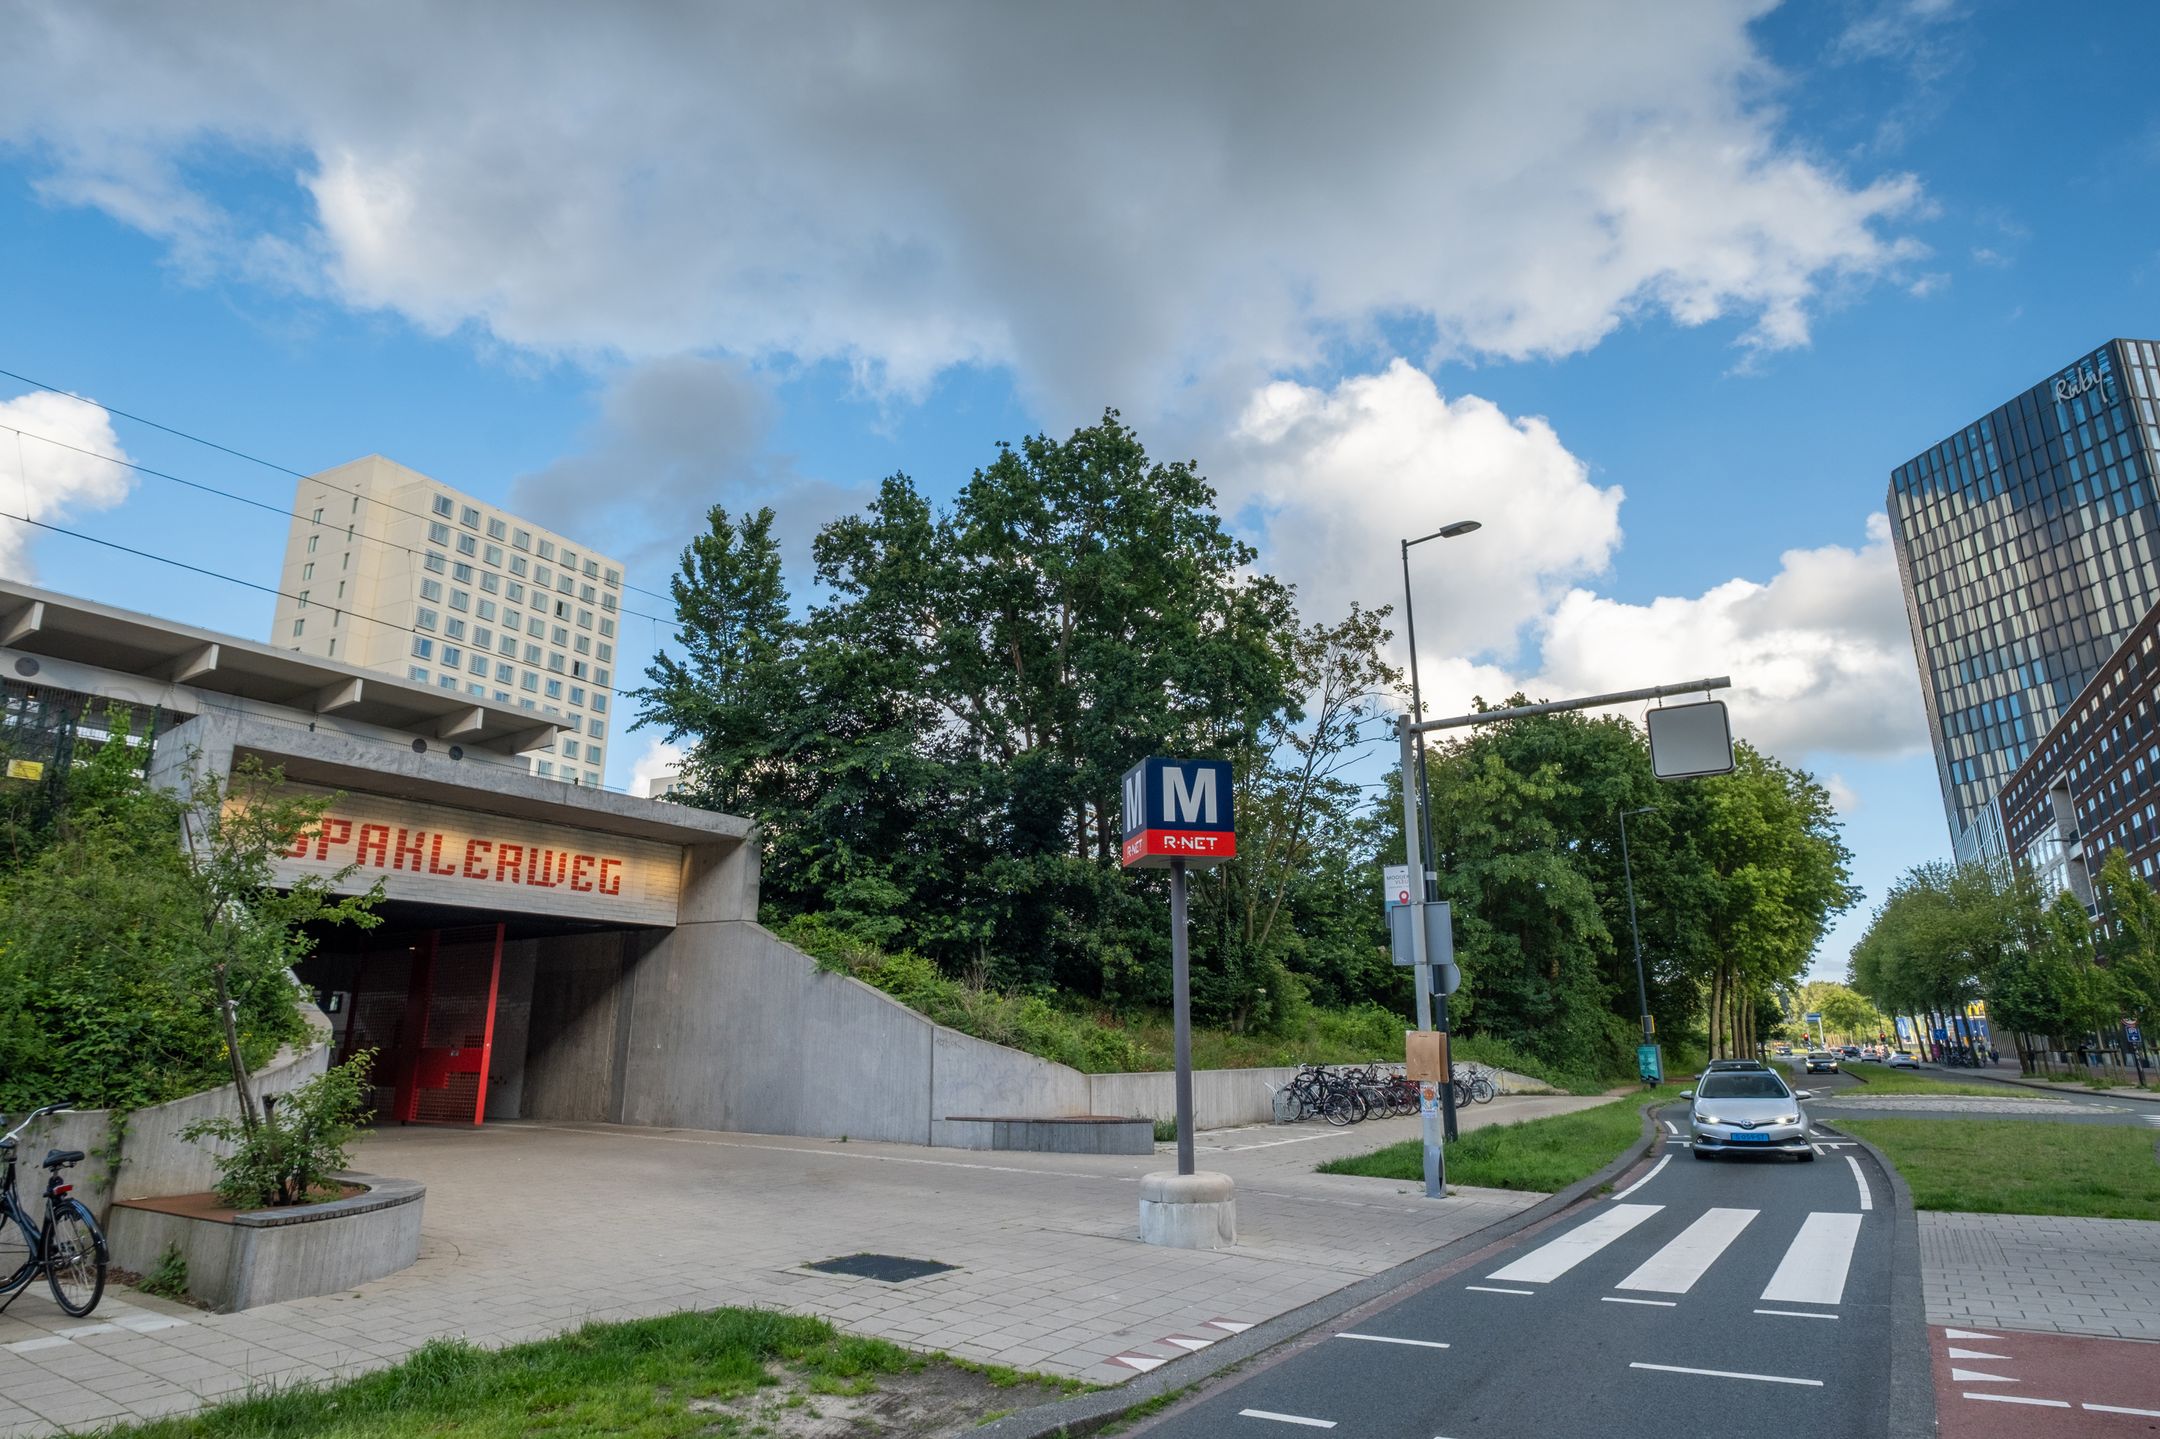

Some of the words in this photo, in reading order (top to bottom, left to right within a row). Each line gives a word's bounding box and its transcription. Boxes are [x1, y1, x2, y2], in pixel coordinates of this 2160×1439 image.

[2055, 367, 2108, 405] Ruby
[1126, 770, 1143, 833] M
[1162, 766, 1218, 824] M
